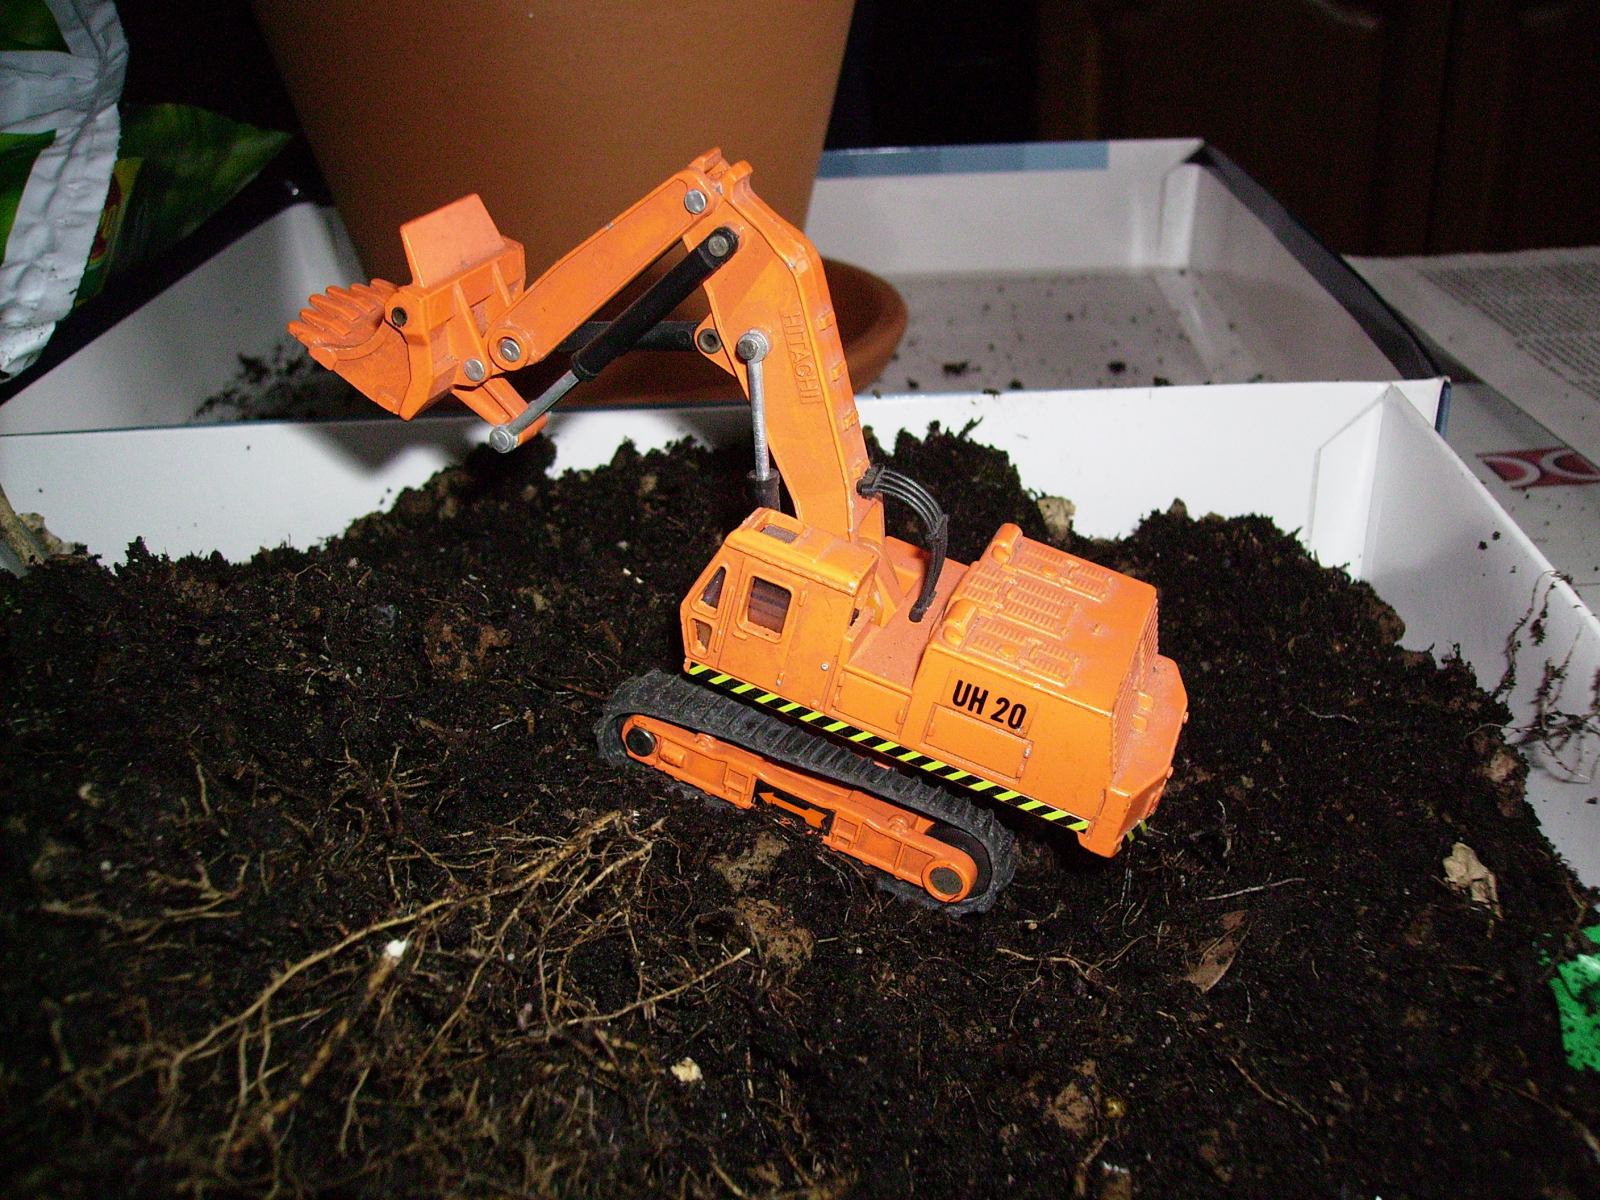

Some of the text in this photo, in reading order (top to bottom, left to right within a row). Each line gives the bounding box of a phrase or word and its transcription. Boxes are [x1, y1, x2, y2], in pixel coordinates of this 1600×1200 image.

[782, 310, 821, 403] HITACHI
[952, 679, 1027, 730] UH 20
